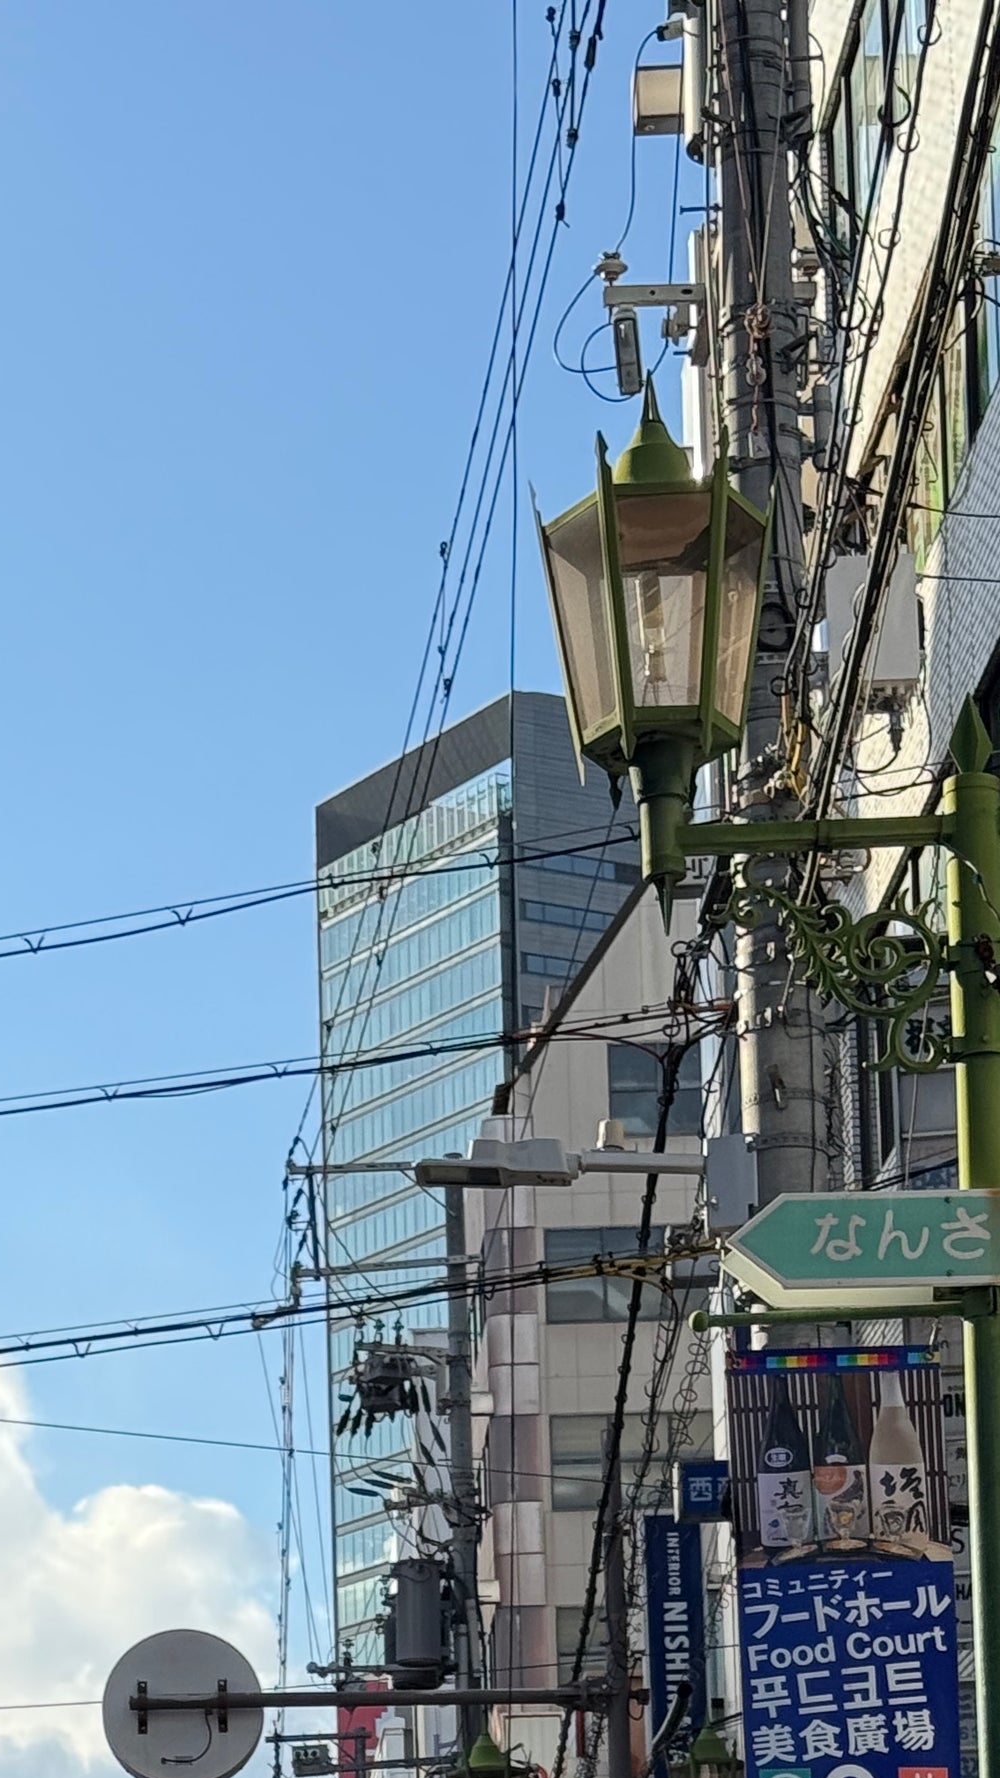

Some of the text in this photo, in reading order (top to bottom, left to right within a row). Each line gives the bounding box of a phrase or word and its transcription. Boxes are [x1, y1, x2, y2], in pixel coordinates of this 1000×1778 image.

[810, 1206, 992, 1262] なんさ
[666, 1531, 681, 1596] INTERIOR
[742, 1569, 893, 1600] コミュニティー
[744, 1585, 951, 1639] フードホール
[748, 1626, 947, 1671] Food Court
[751, 1661, 927, 1719] 푸드코트
[752, 1709, 935, 1767] 美食廣場
